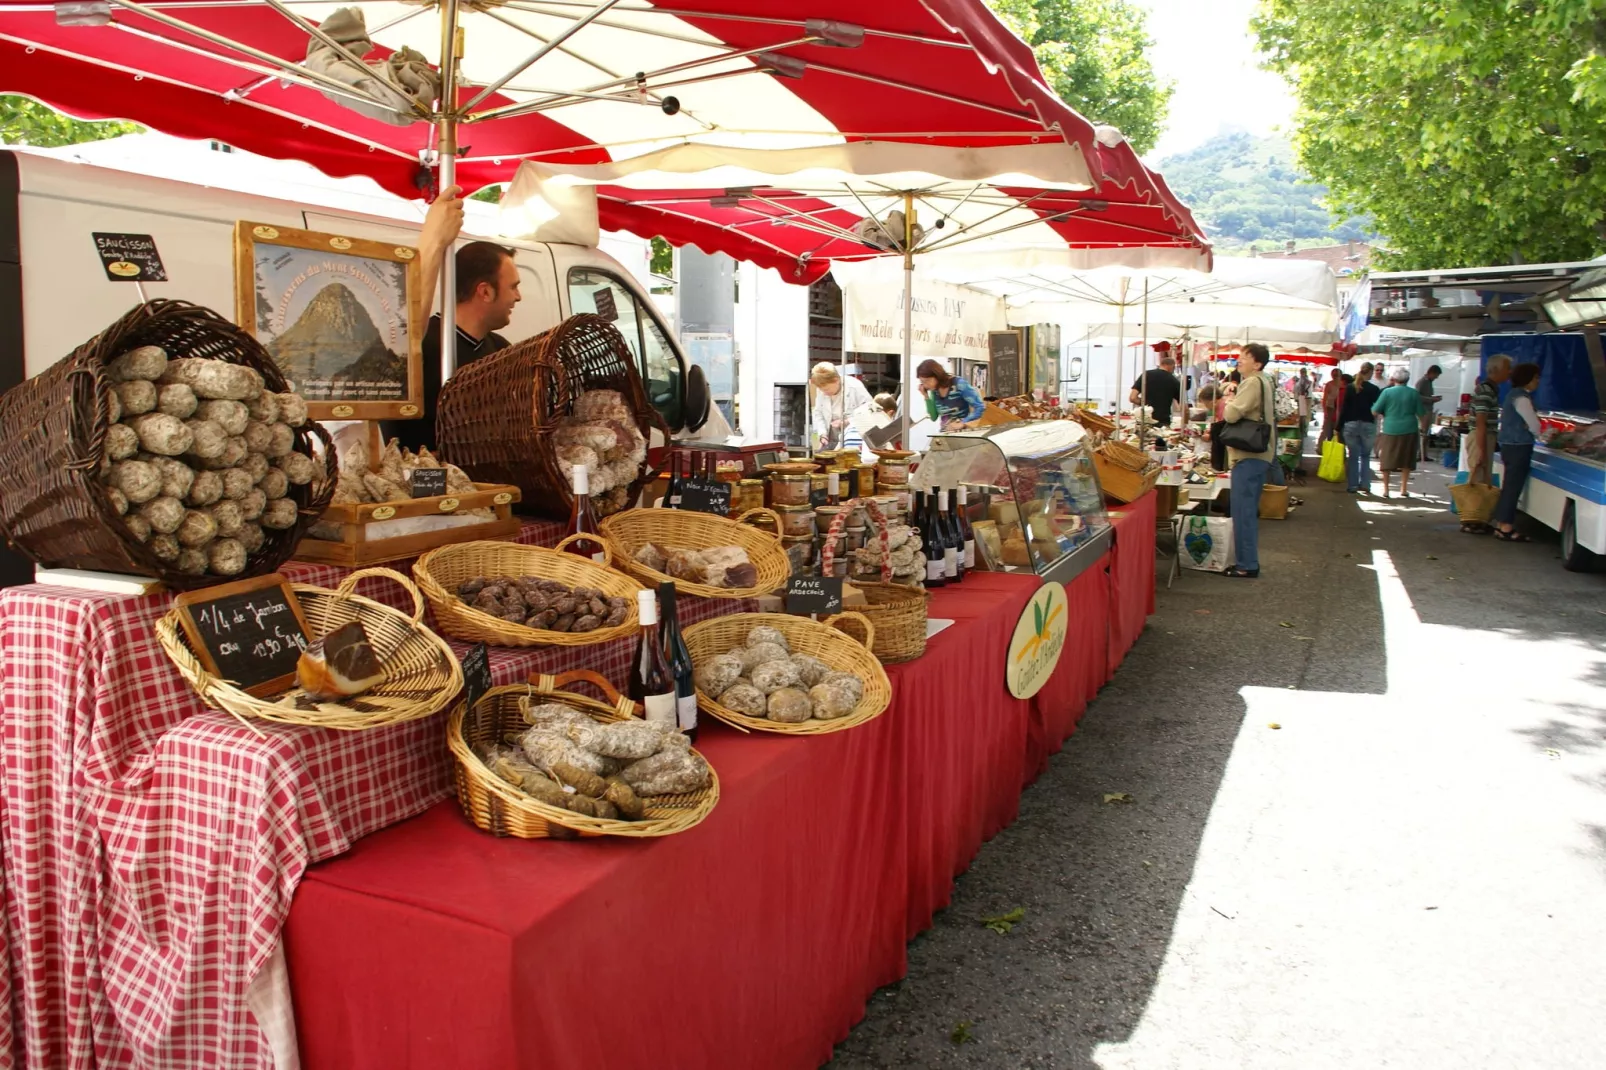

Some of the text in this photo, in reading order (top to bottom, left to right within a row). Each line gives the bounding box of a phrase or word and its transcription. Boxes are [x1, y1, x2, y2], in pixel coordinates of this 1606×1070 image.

[98, 238, 153, 250] SAUCISSON
[307, 265, 321, 277] du
[323, 261, 348, 273] Mont
[795, 580, 820, 588] PAVE
[200, 600, 287, 635] 1/4 de Jambon
